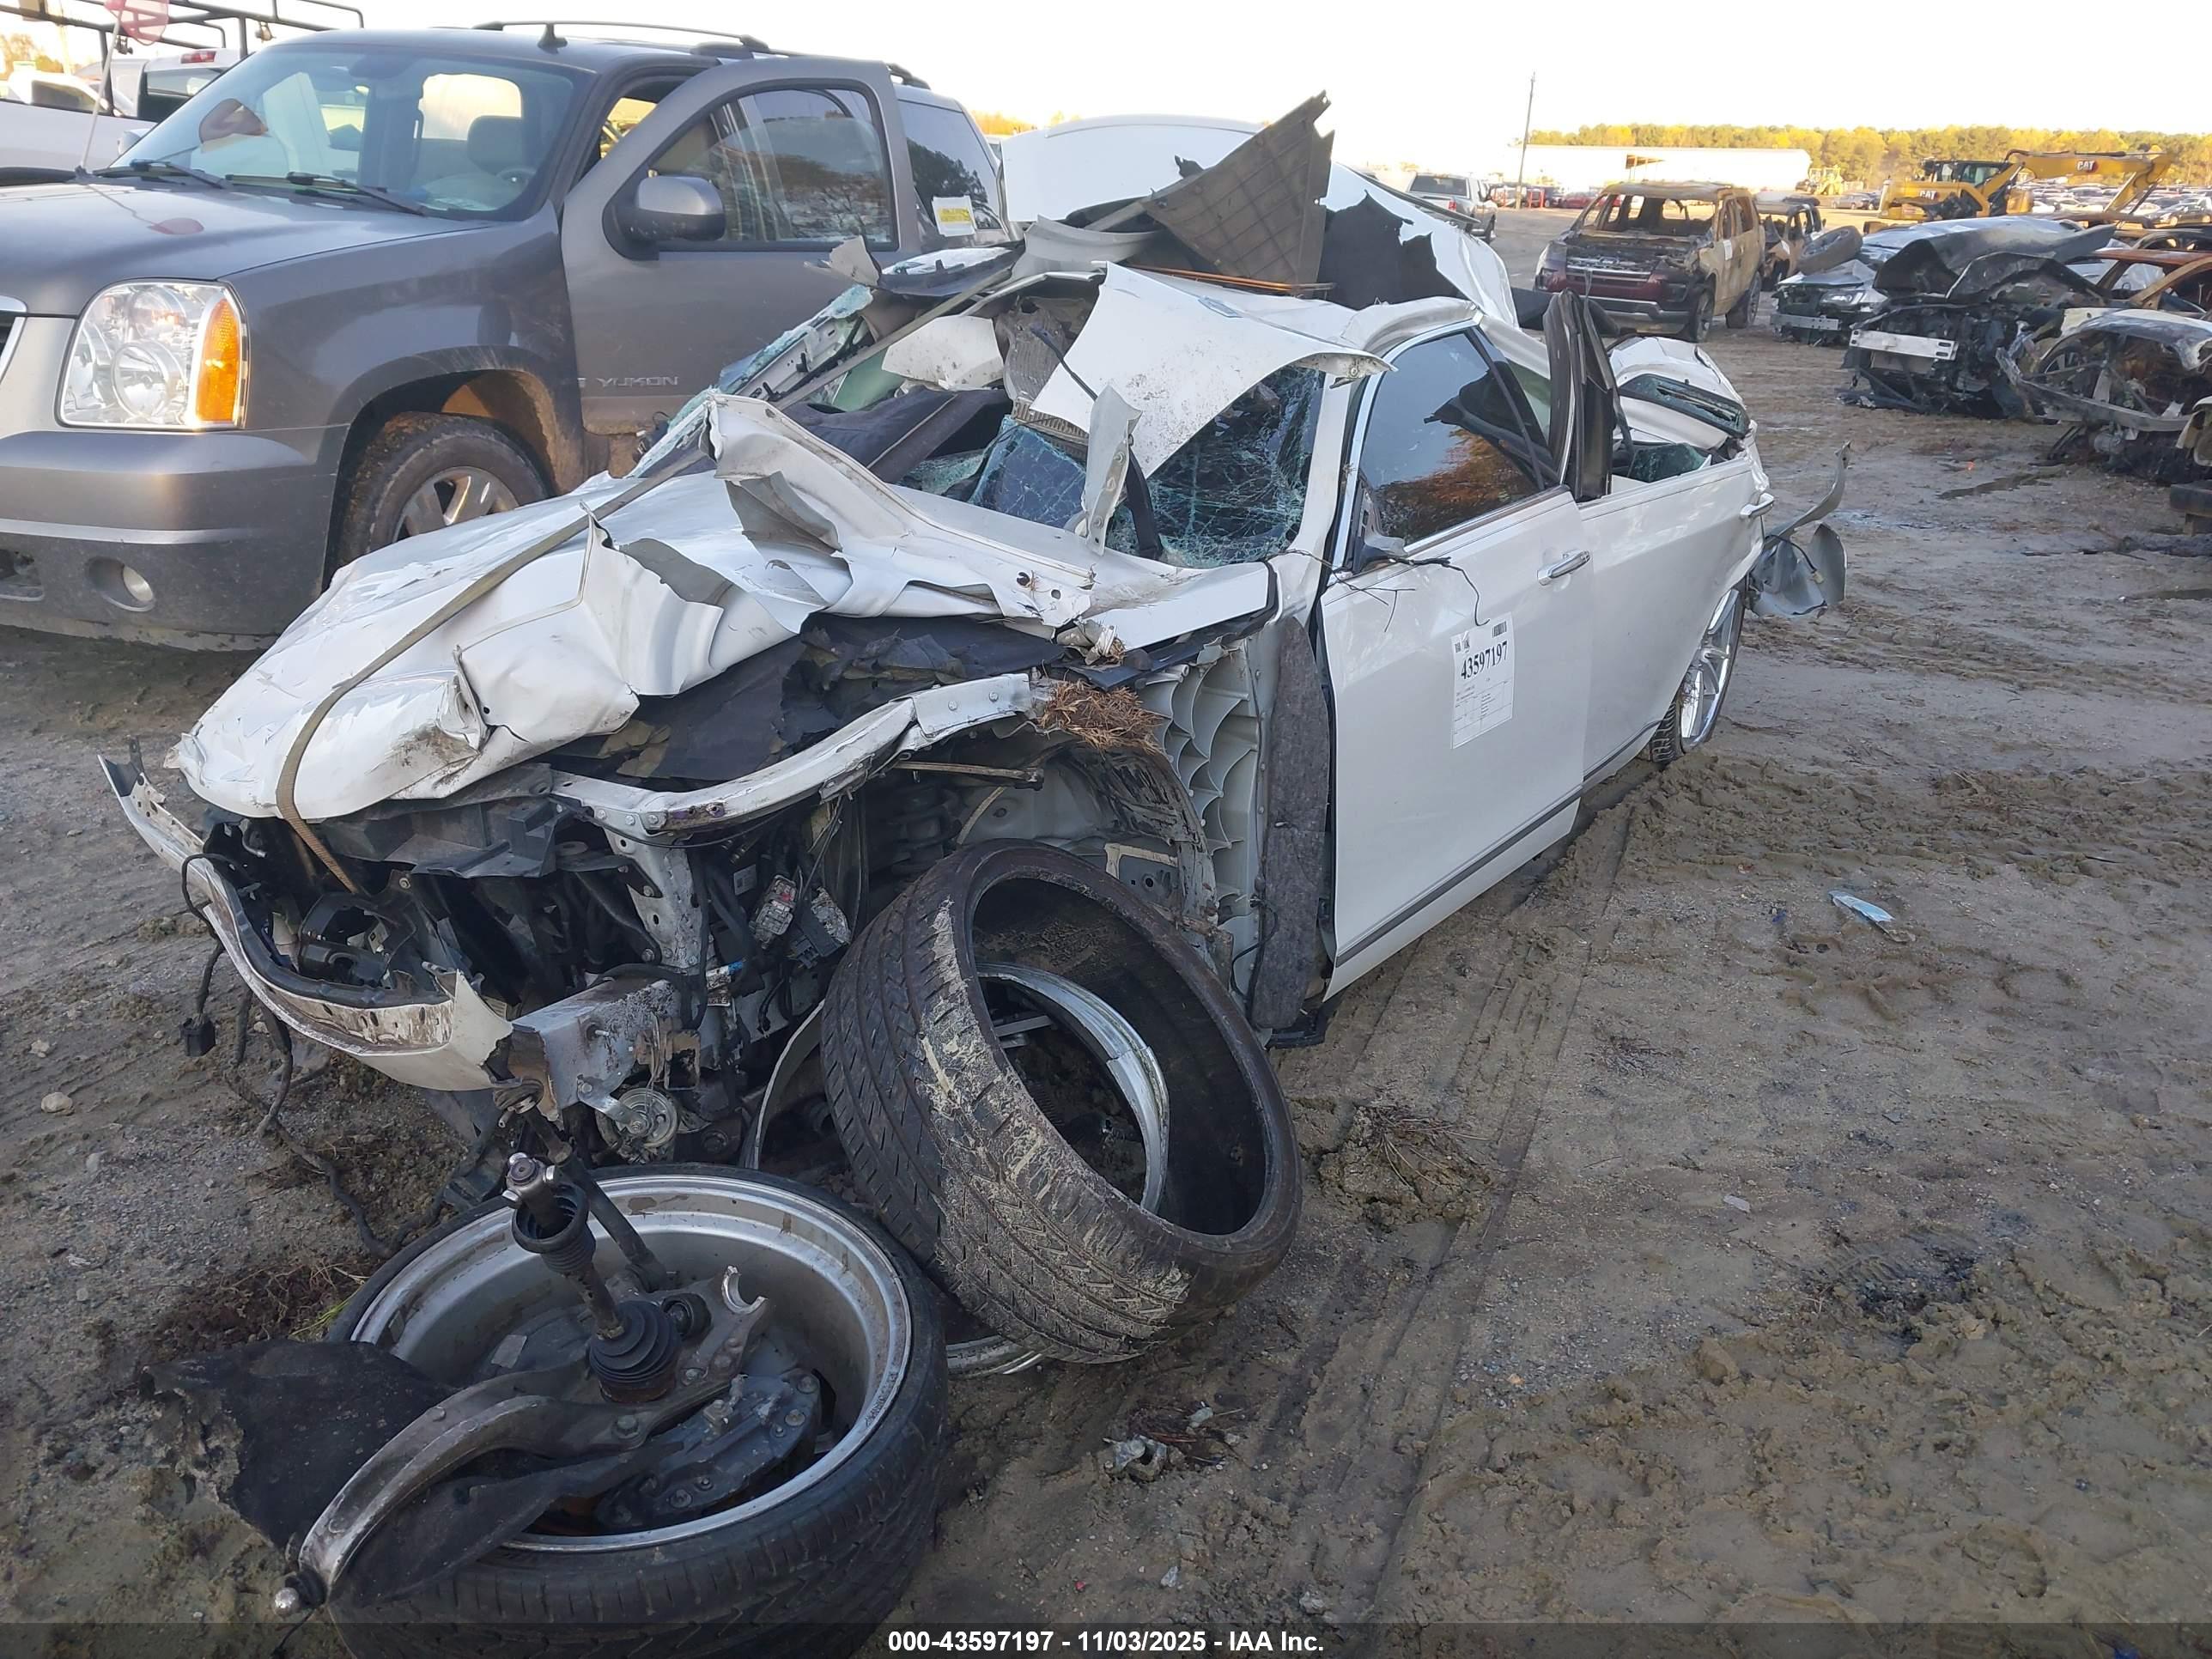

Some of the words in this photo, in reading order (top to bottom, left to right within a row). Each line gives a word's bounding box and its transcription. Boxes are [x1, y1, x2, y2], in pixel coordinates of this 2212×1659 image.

[2076, 161, 2095, 171] CAT
[1919, 191, 1937, 200] CAT
[596, 376, 678, 387] YUKON
[1461, 641, 1508, 679] 43597197
